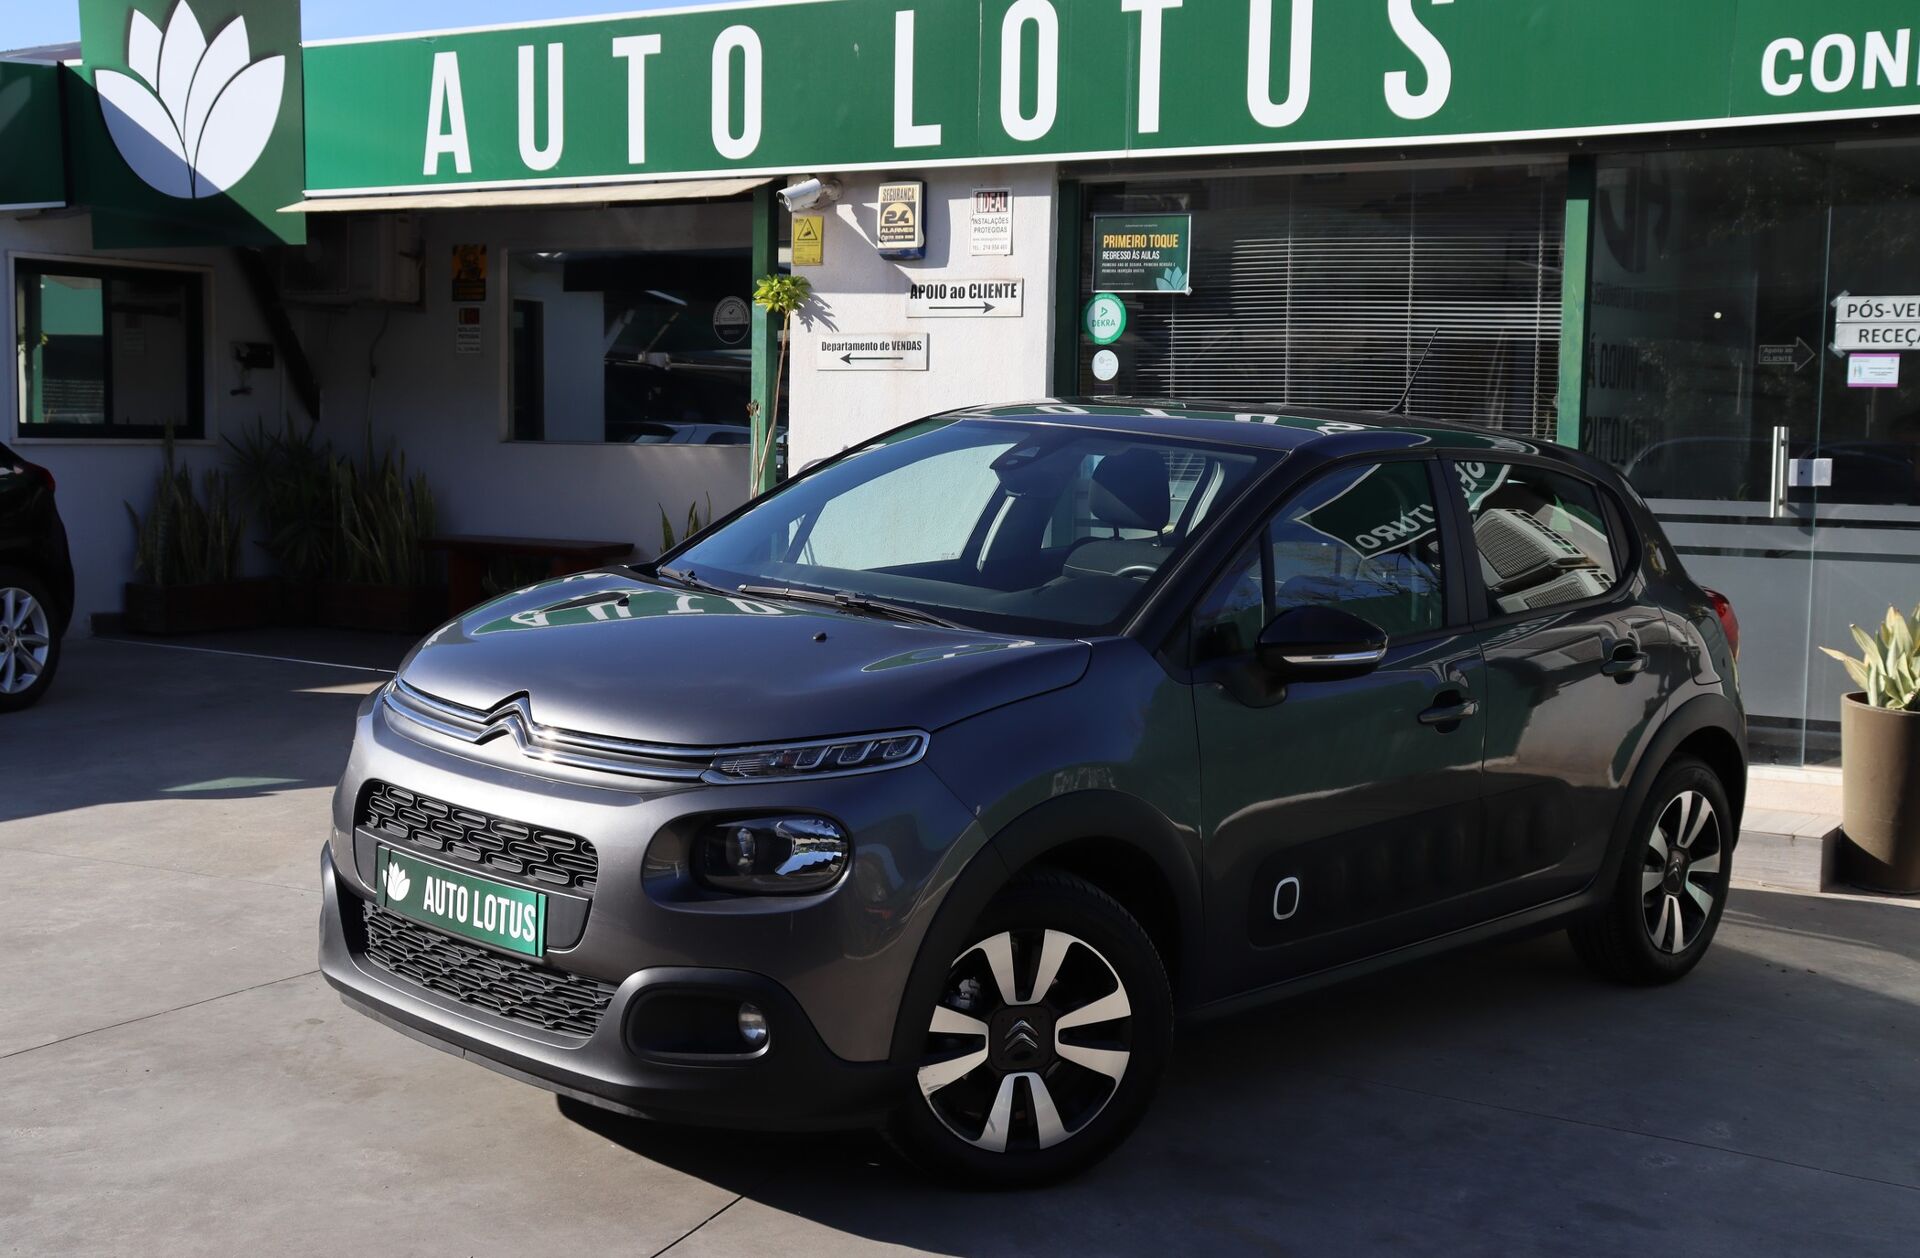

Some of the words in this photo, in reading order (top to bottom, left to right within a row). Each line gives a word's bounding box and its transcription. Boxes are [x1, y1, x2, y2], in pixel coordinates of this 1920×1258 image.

[1760, 28, 1920, 97] CON
[423, 25, 762, 176] AUTO
[893, 0, 1455, 149] LOTUS
[884, 210, 909, 224] 24
[1103, 234, 1147, 248] PRIMEIRO
[1149, 234, 1179, 248] TOQUE
[1102, 250, 1131, 260] REGRESSO
[1140, 250, 1160, 260] AULAS
[910, 284, 947, 300] APOIO
[949, 286, 966, 300] ao
[968, 283, 1017, 299] CLIENTE
[1847, 300, 1920, 318] PÓS-VE
[1091, 319, 1116, 328] DEKRA
[1858, 329, 1920, 346] RECEÇ
[821, 341, 878, 353] Departamento
[879, 341, 890, 351] de
[891, 340, 922, 351] VENDAS
[423, 875, 469, 923] AUTO
[473, 890, 537, 942] LOTUS
